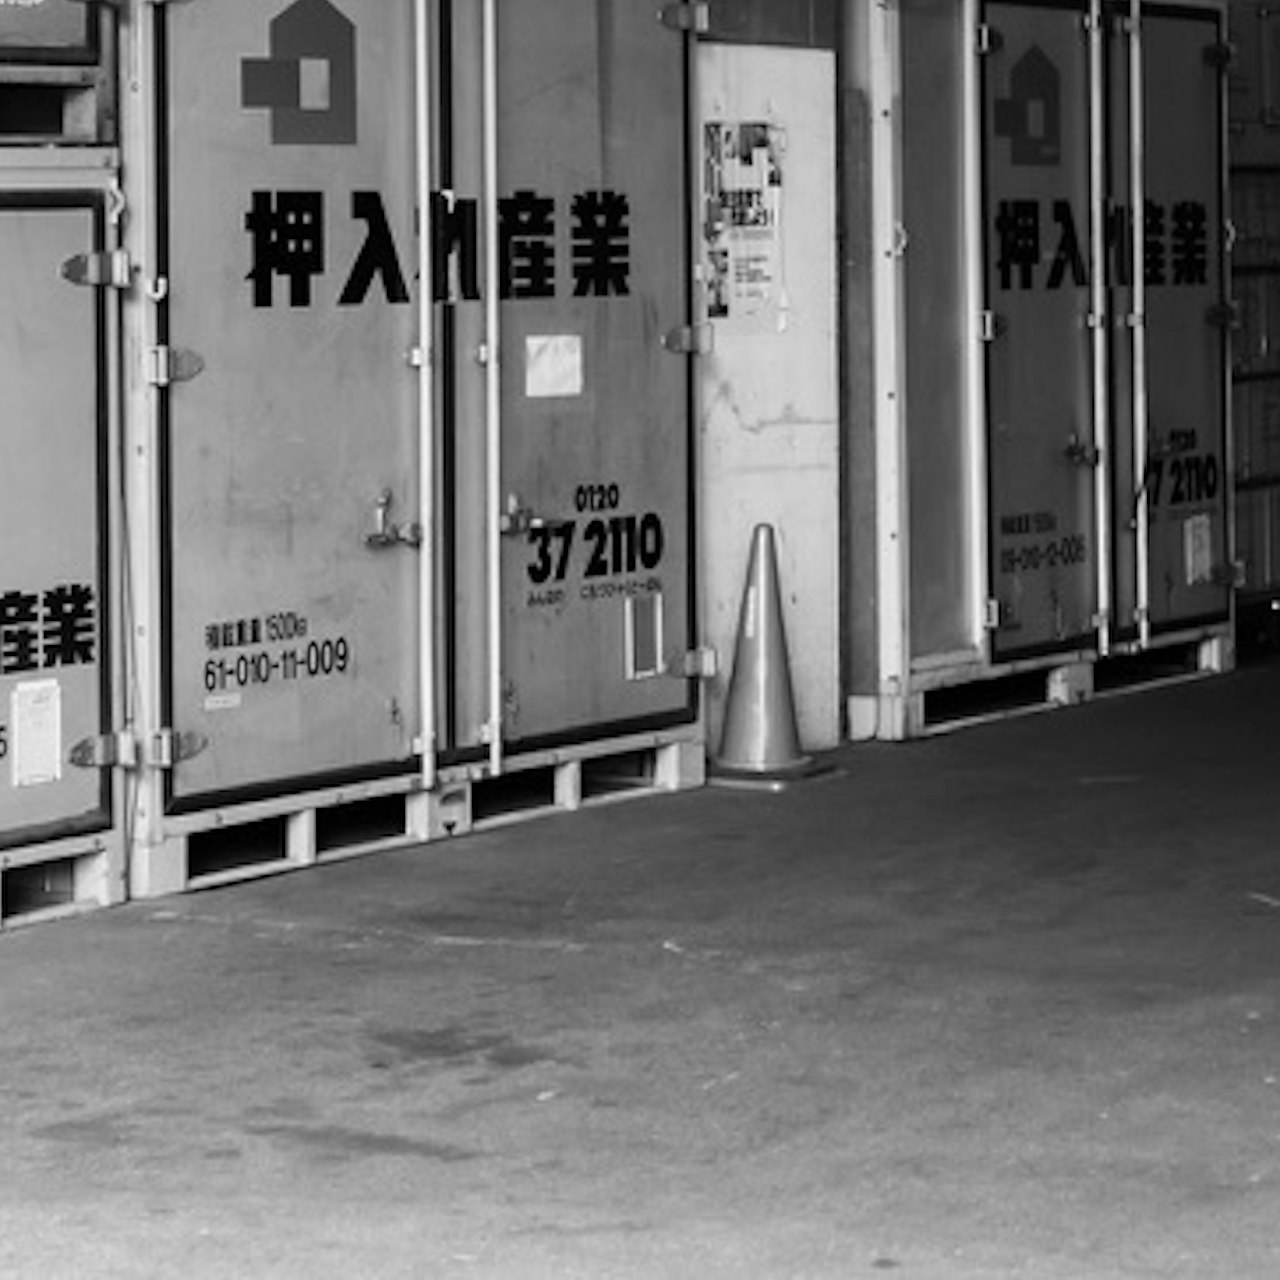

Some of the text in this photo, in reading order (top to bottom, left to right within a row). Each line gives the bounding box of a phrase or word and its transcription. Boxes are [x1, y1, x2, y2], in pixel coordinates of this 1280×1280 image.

[244, 190, 630, 307] 押入れ産業
[995, 200, 1206, 290] 押入れ産業
[577, 483, 619, 512] 0120
[528, 513, 663, 583] 37 2110
[205, 637, 348, 692] 61-010-11-009
